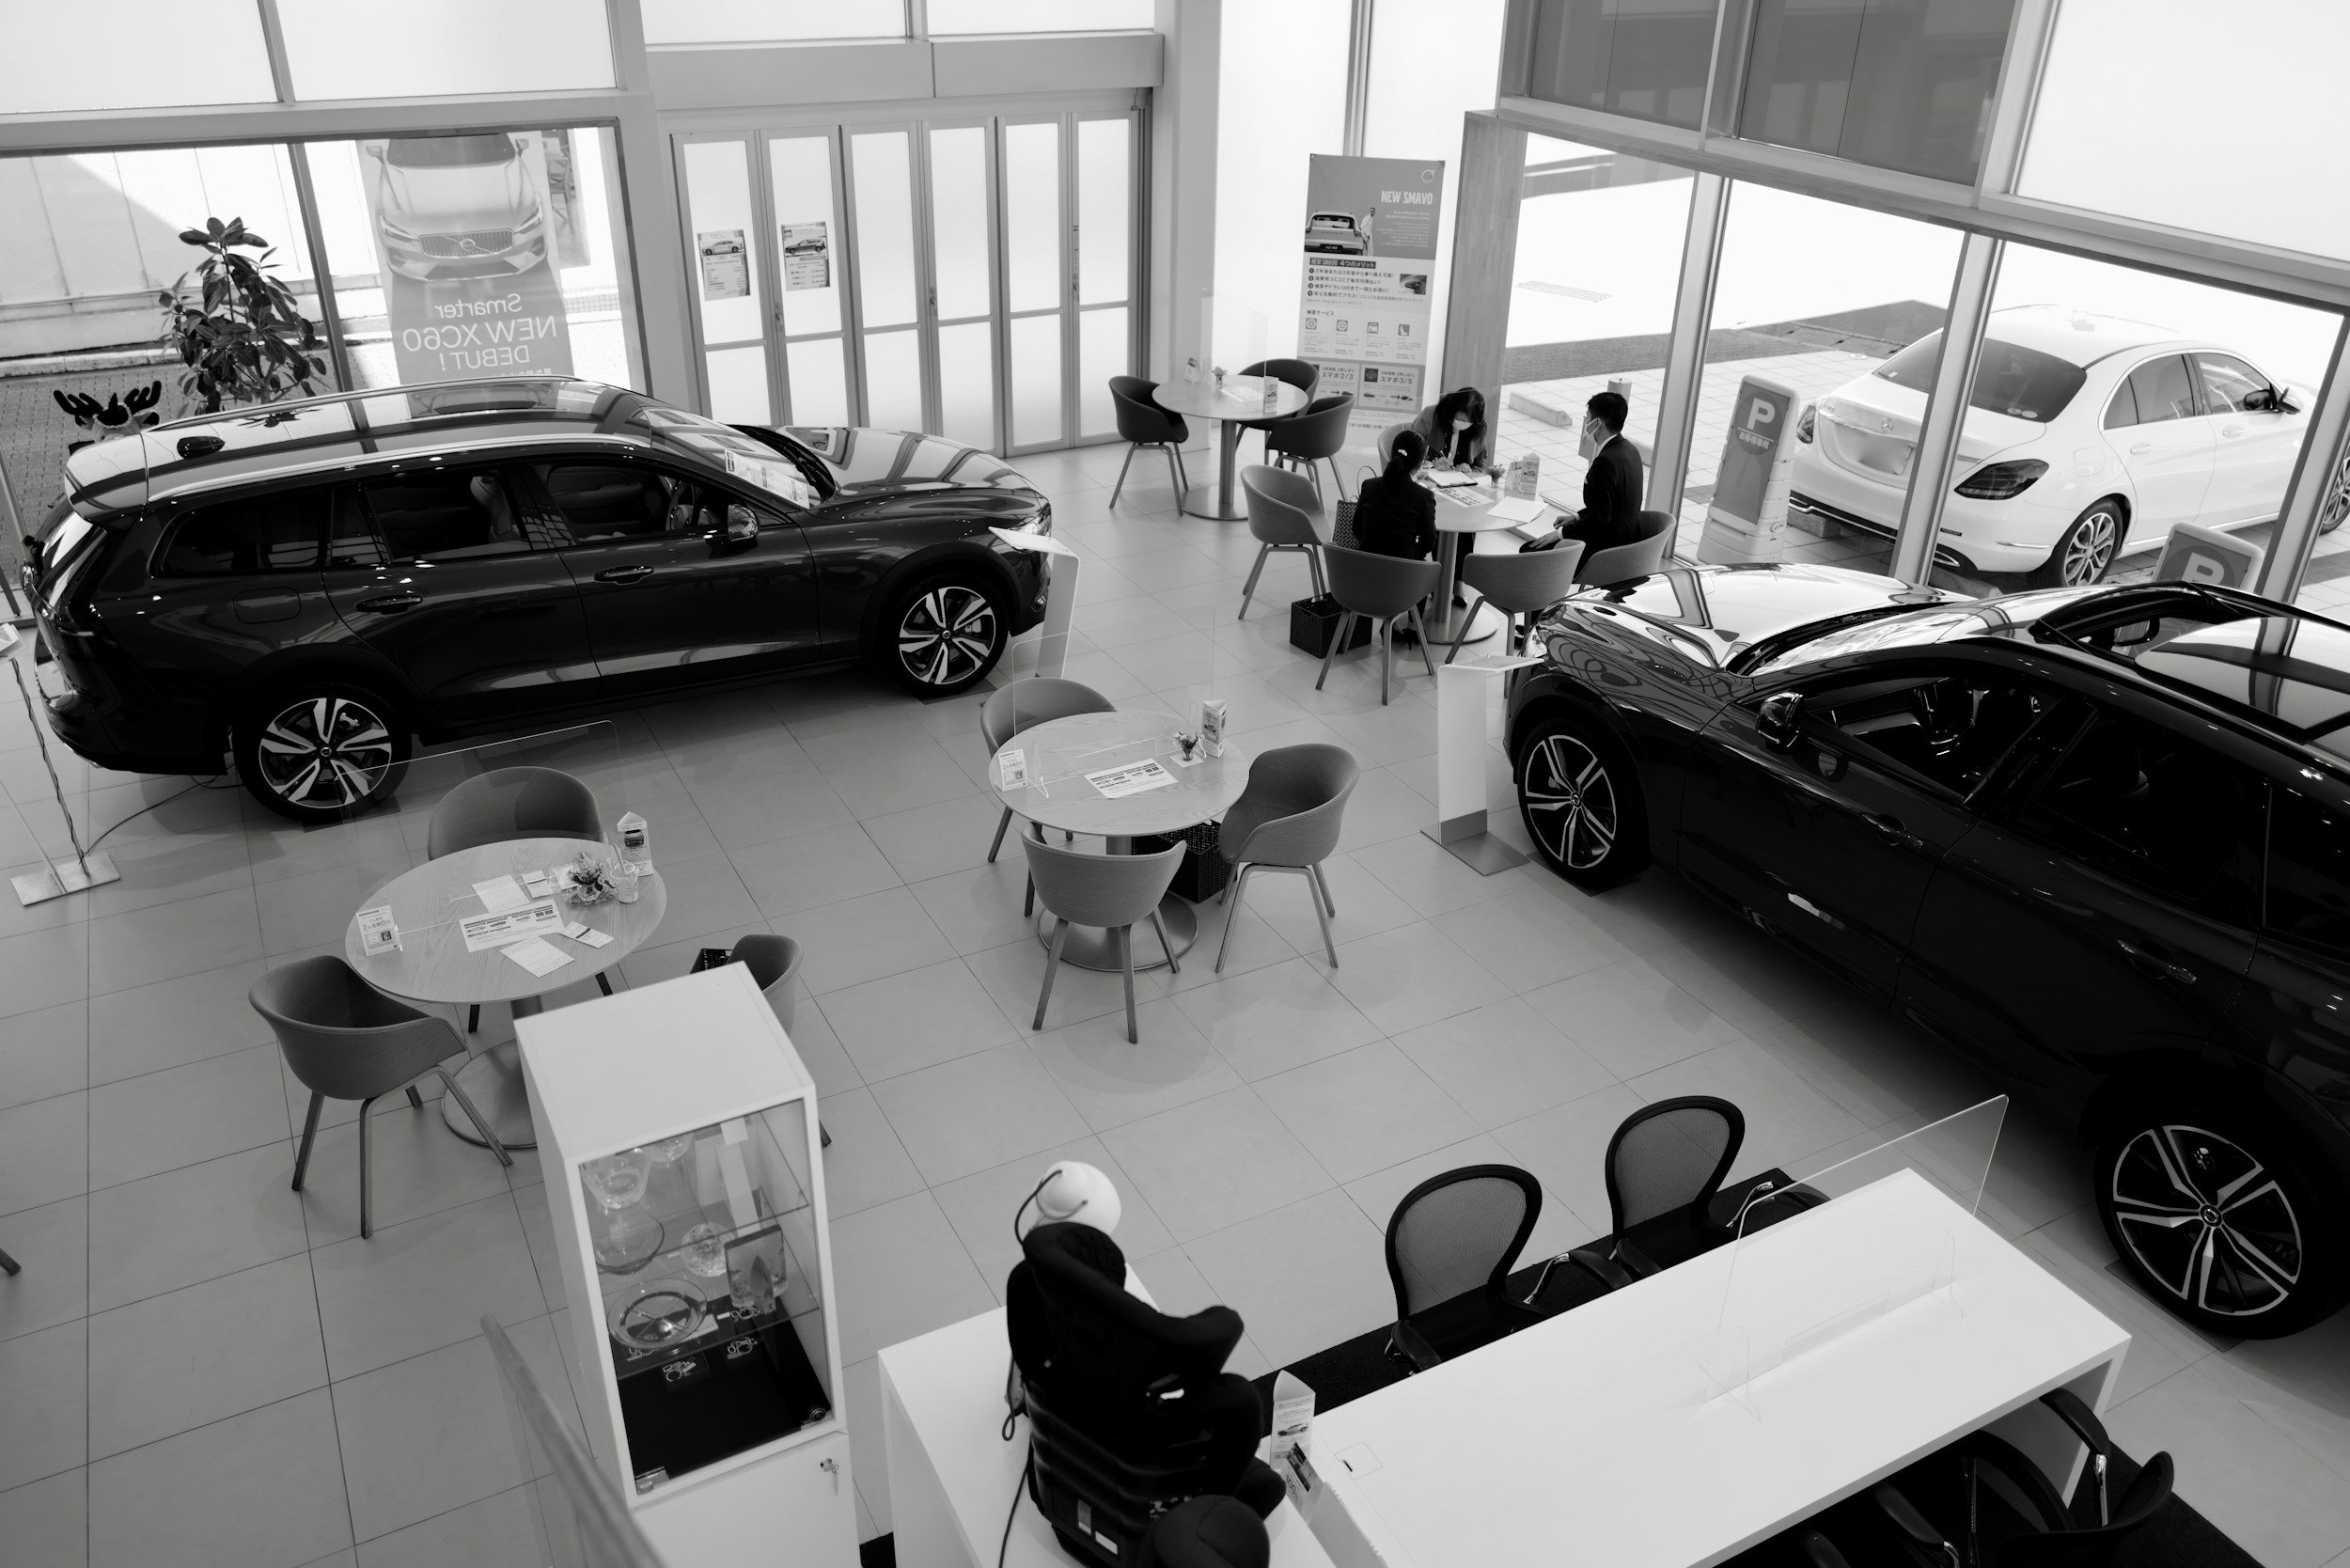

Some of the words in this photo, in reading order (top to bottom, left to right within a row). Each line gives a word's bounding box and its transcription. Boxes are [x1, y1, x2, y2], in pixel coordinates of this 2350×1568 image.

[1381, 190, 1402, 203] NEW
[1403, 192, 1434, 205] SMAVO
[1747, 397, 1776, 431] P
[1739, 431, 1770, 450] お客様専用
[2181, 552, 2225, 585] P
